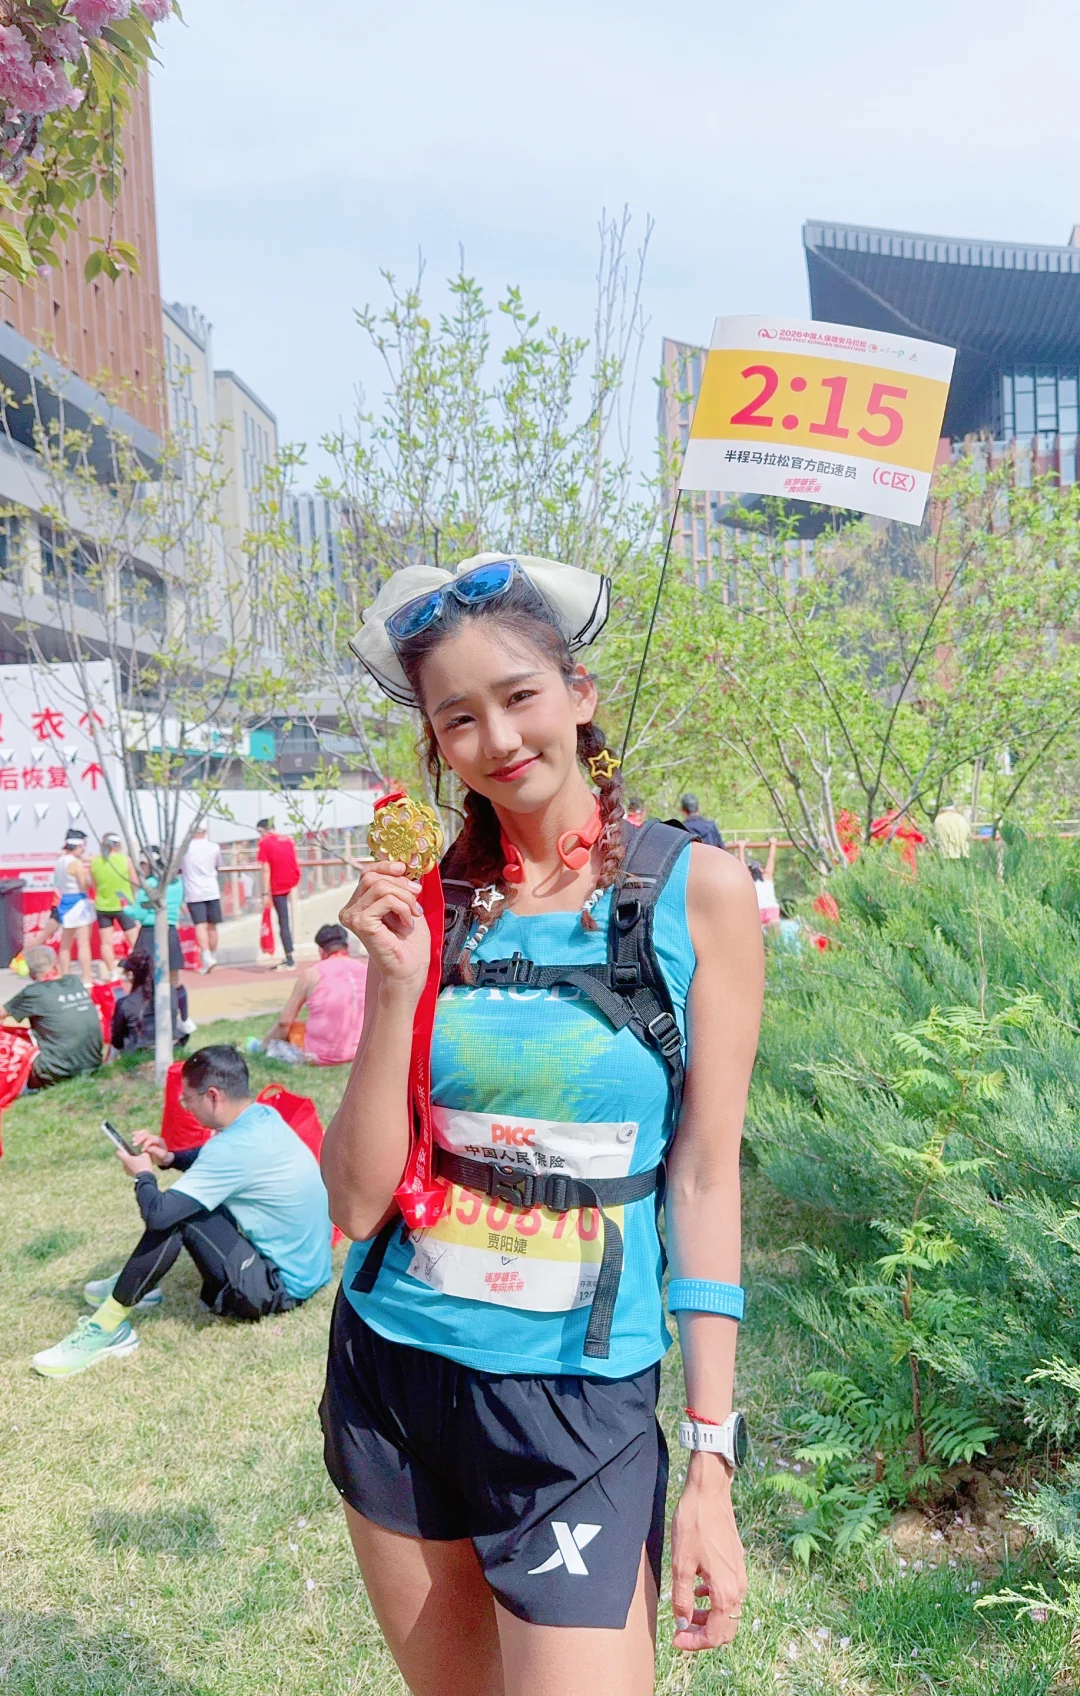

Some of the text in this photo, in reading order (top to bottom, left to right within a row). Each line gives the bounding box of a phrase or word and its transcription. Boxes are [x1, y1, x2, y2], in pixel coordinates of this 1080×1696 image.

[730, 364, 908, 447] 2:15
[724, 450, 857, 480] 半程马拉松官方配速员
[491, 1124, 536, 1147] PICC
[464, 1144, 566, 1168] 中国人民保险
[487, 1232, 528, 1254] 贾阳婕
